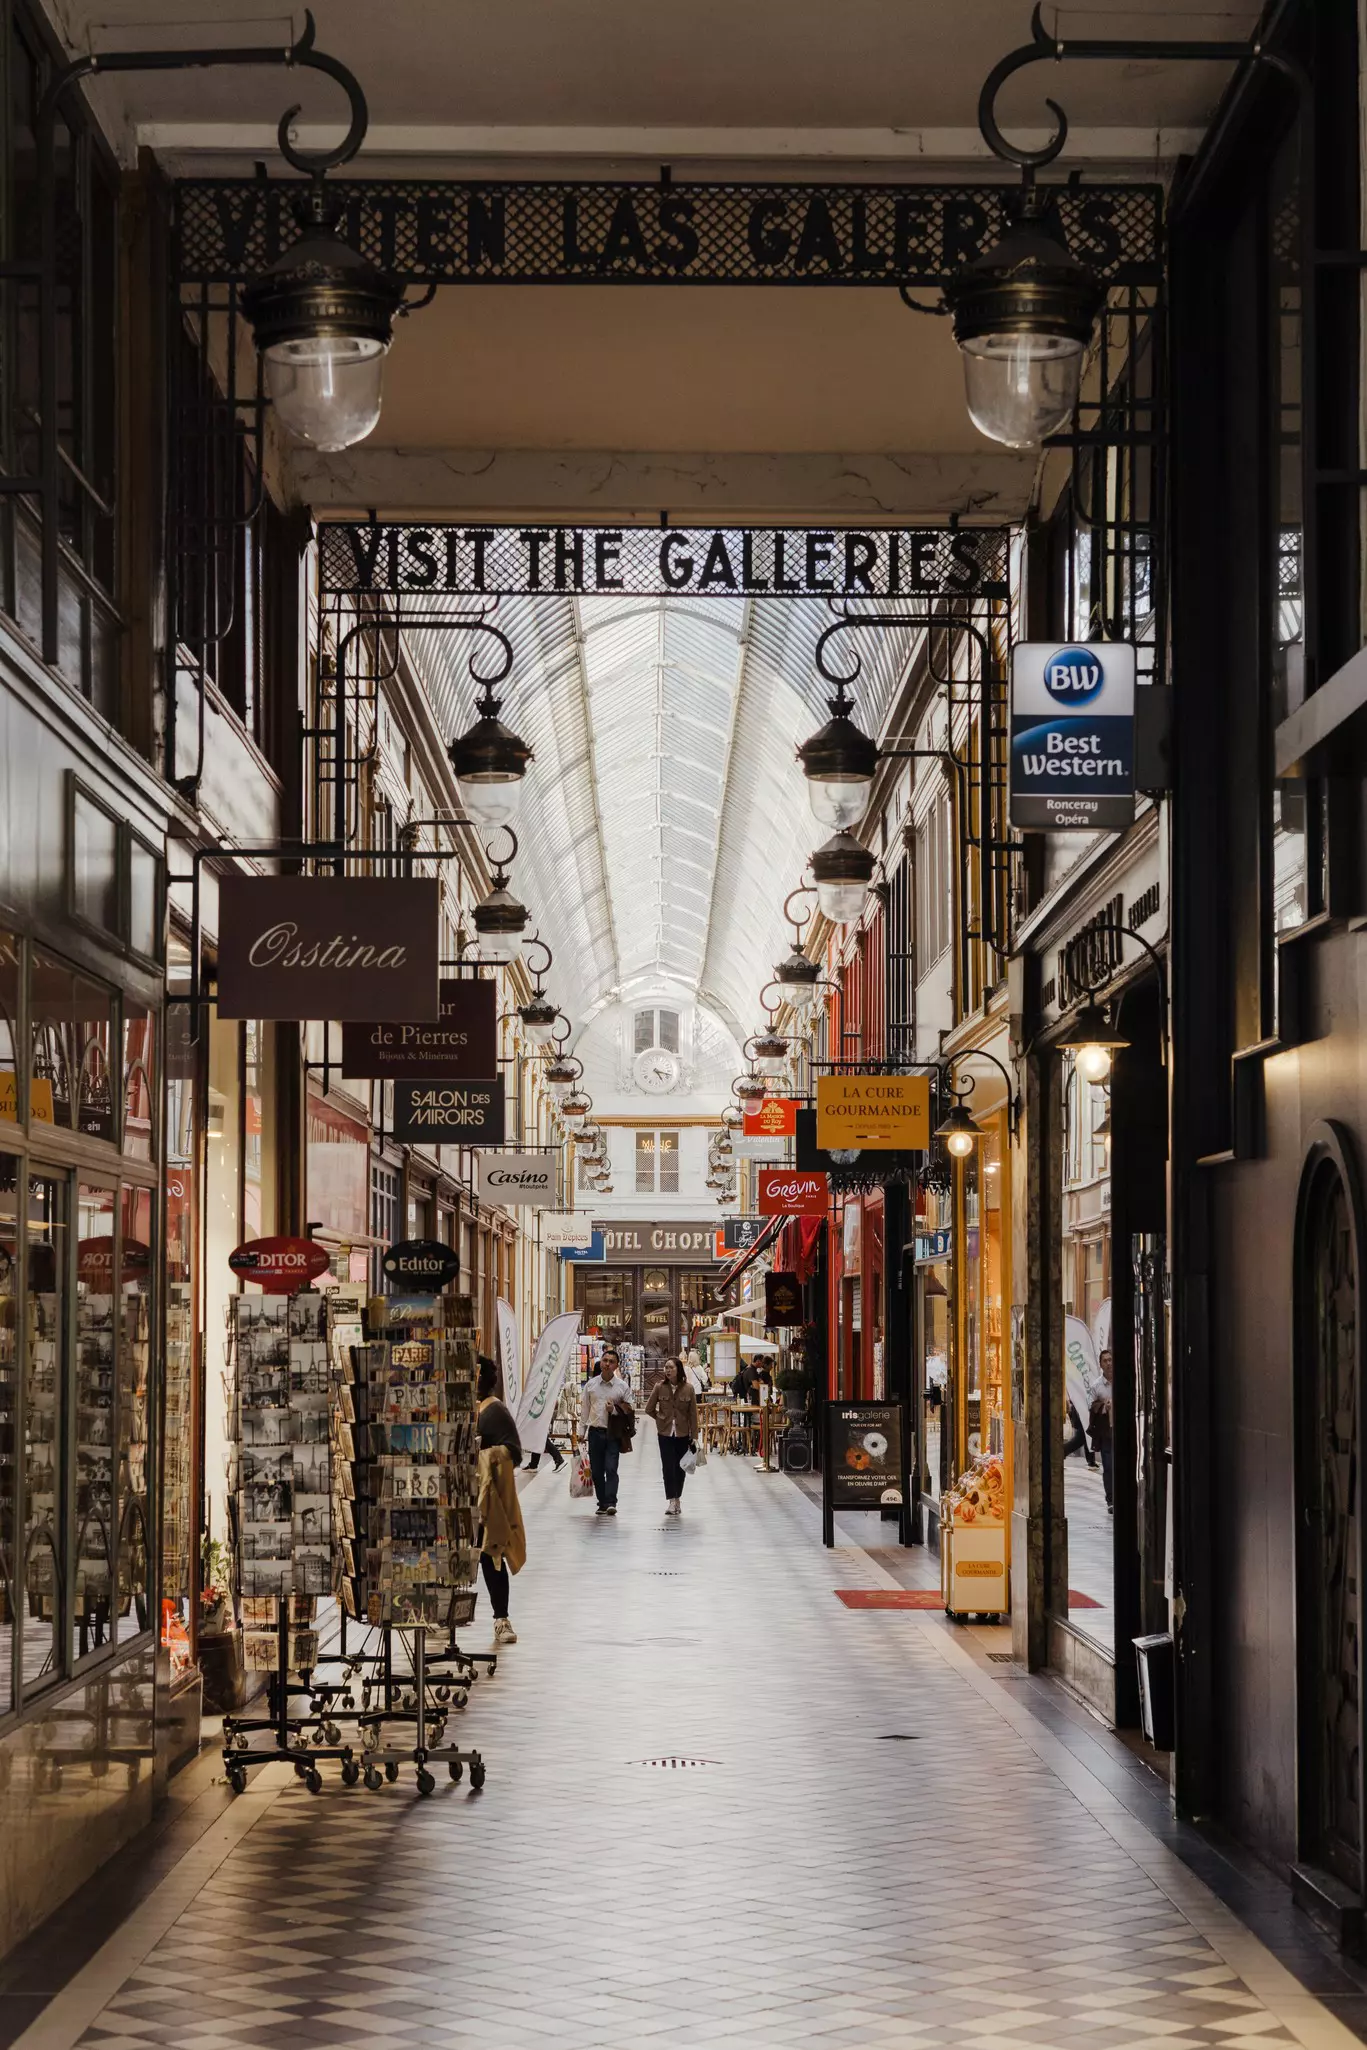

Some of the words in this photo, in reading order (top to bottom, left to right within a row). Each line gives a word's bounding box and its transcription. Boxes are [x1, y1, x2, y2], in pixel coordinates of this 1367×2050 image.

[211, 192, 506, 269] VIITEN
[561, 192, 700, 270] LAS
[349, 529, 495, 588] VISIT
[519, 529, 624, 588] THE
[659, 529, 981, 593] GALLERIES
[1051, 665, 1099, 690] BW
[1047, 732, 1101, 754] Best
[1022, 754, 1124, 776] Western
[1047, 799, 1098, 812] Ronceray
[1055, 814, 1089, 825] Opéra
[249, 921, 407, 968] Osstina
[371, 1025, 393, 1045] de
[400, 1025, 468, 1045] Pierres
[379, 1051, 405, 1062] Bijoux
[418, 1051, 458, 1061] Minéraux
[411, 1090, 468, 1107] SALON
[471, 1094, 490, 1104] DES
[843, 1087, 861, 1098] LA
[865, 1087, 904, 1098] CURE
[408, 1108, 485, 1125] MIROIRS
[825, 1104, 921, 1116] GOURMANDE
[487, 1169, 549, 1186] Casino
[606, 1230, 641, 1250] ÔTEL
[651, 1229, 712, 1250] CHOPI
[399, 1256, 445, 1272] Editor
[394, 1347, 431, 1362] PARIS
